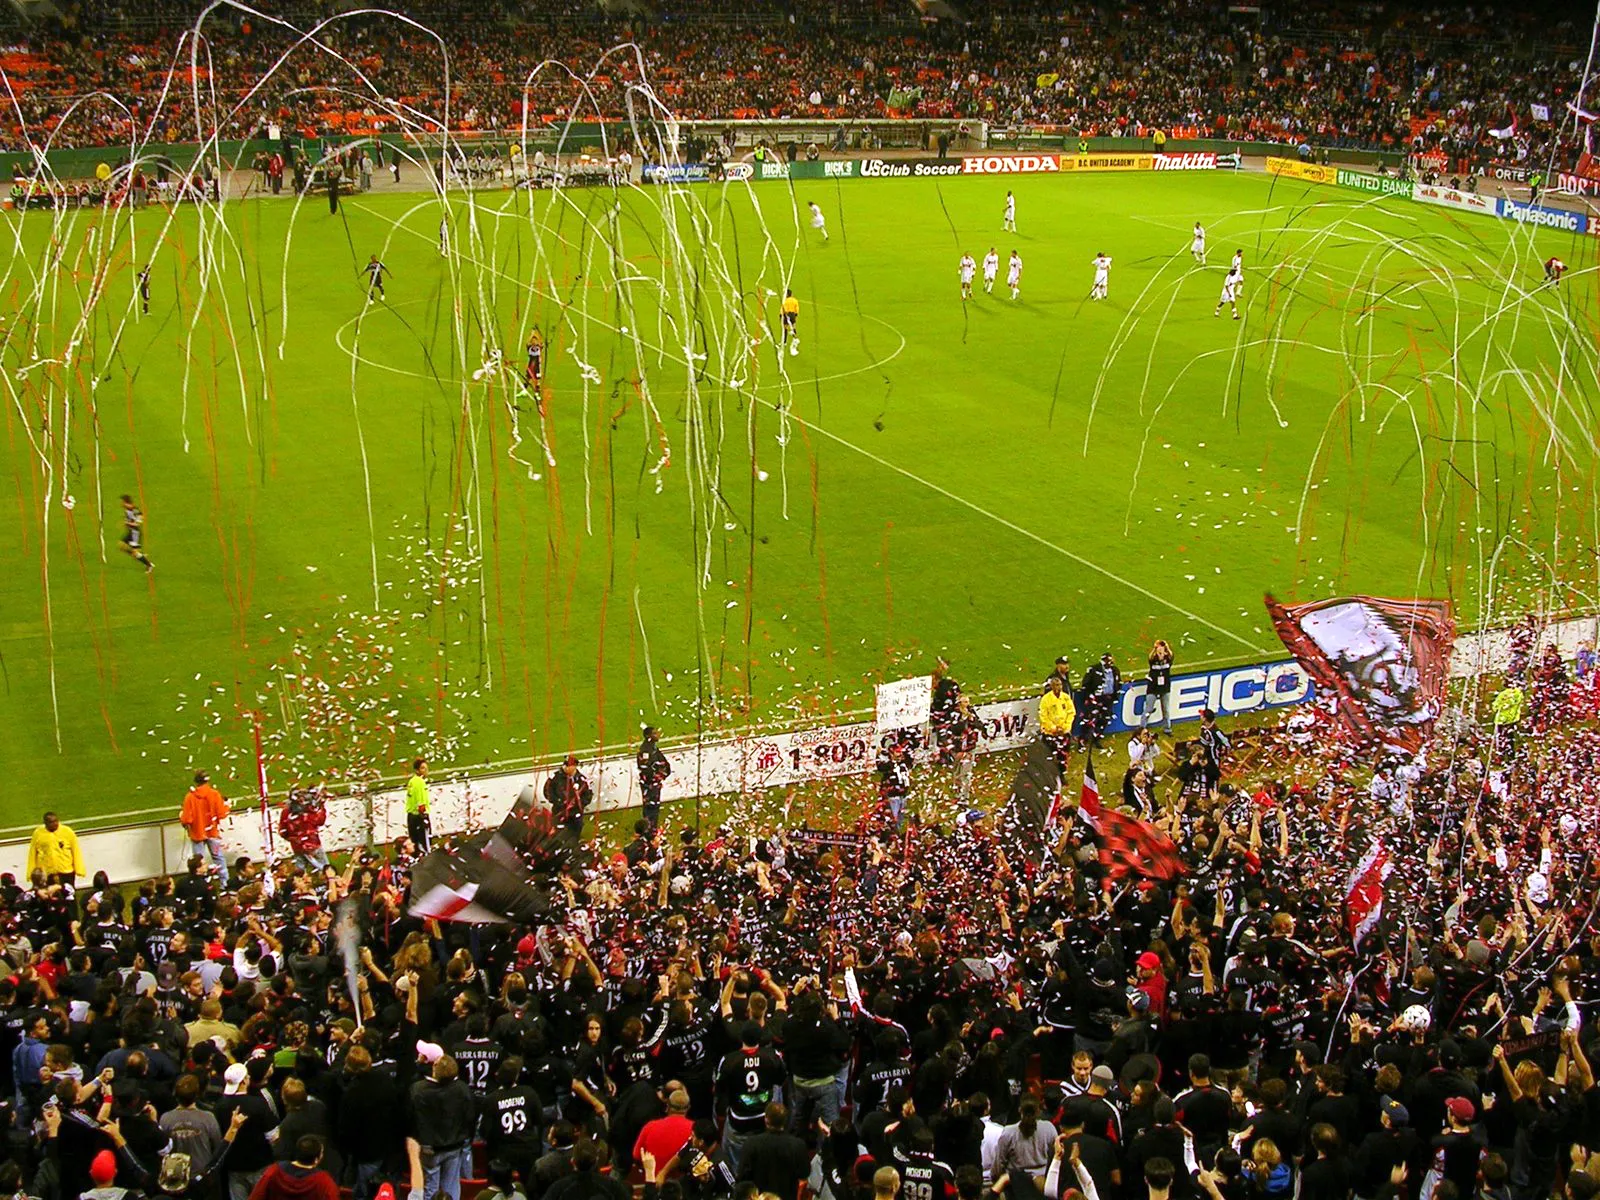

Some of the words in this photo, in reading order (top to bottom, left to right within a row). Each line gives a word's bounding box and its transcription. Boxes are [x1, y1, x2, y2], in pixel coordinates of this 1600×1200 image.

[914, 164, 962, 176] Soccer
[963, 156, 1061, 174] HONDA
[1090, 159, 1109, 168] UNITED
[1109, 159, 1135, 167] ACADEMY
[1345, 172, 1380, 191] UNITED
[1382, 178, 1411, 197] BANK
[1502, 200, 1578, 231] Panasonic
[1122, 660, 1310, 727] GEICO
[744, 1057, 760, 1068] ADU
[465, 1060, 490, 1088] 12
[745, 1070, 759, 1092] 9
[498, 1096, 526, 1110] MORENO
[501, 1109, 527, 1134] 99
[906, 1167, 932, 1179] MORENO
